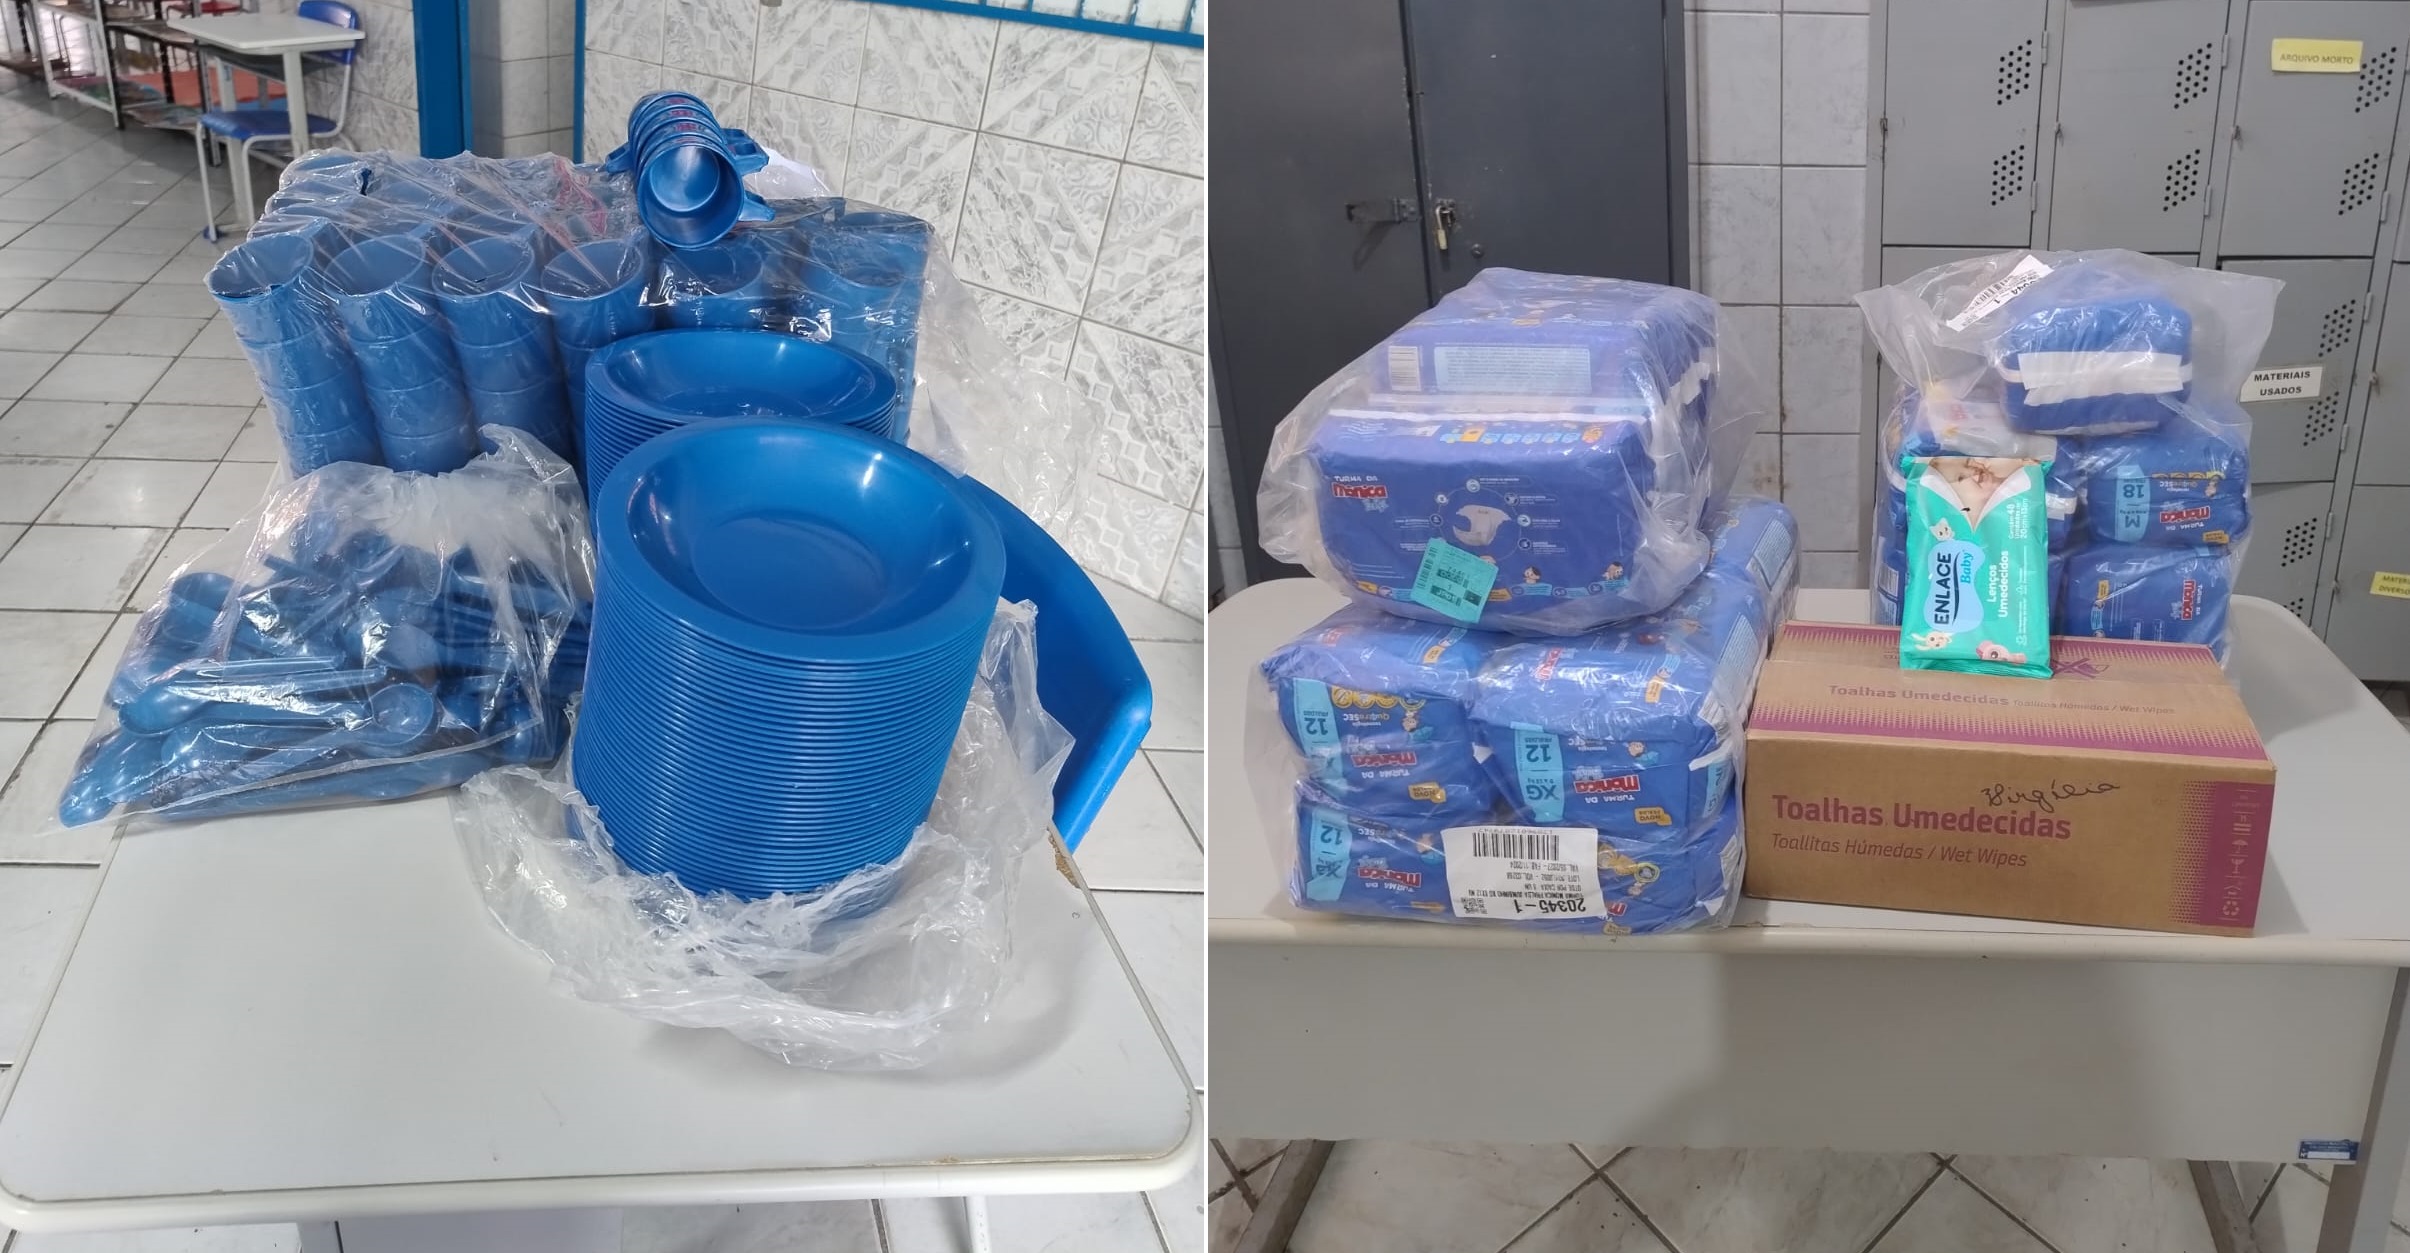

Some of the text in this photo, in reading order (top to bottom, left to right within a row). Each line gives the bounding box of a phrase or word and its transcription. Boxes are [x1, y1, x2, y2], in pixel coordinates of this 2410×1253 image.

[2280, 53, 2354, 65] ARQUIVO MORTO
[2253, 371, 2311, 382] MATERIAIS
[2260, 386, 2302, 396] USADOS
[2123, 484, 2145, 498] 18
[2125, 514, 2140, 528] M
[1960, 552, 1974, 584] Baby
[1935, 552, 1951, 625] ENLACE
[1987, 564, 1998, 603] Lenços
[1998, 550, 2009, 618] Umedecidos
[1829, 684, 1897, 699] Toalhas
[1902, 689, 2009, 706] Umedecidas
[1303, 717, 1329, 735] 12
[1526, 744, 1552, 762] 12
[1379, 769, 1411, 778] TURMA
[1527, 784, 1560, 800] XG
[1603, 794, 1635, 802] TURMA
[1772, 794, 2072, 840] Toalhas Umedecidas
[1320, 824, 1343, 845] 12
[1772, 833, 2027, 869] Toallitas Húmedas / Wet Wipes
